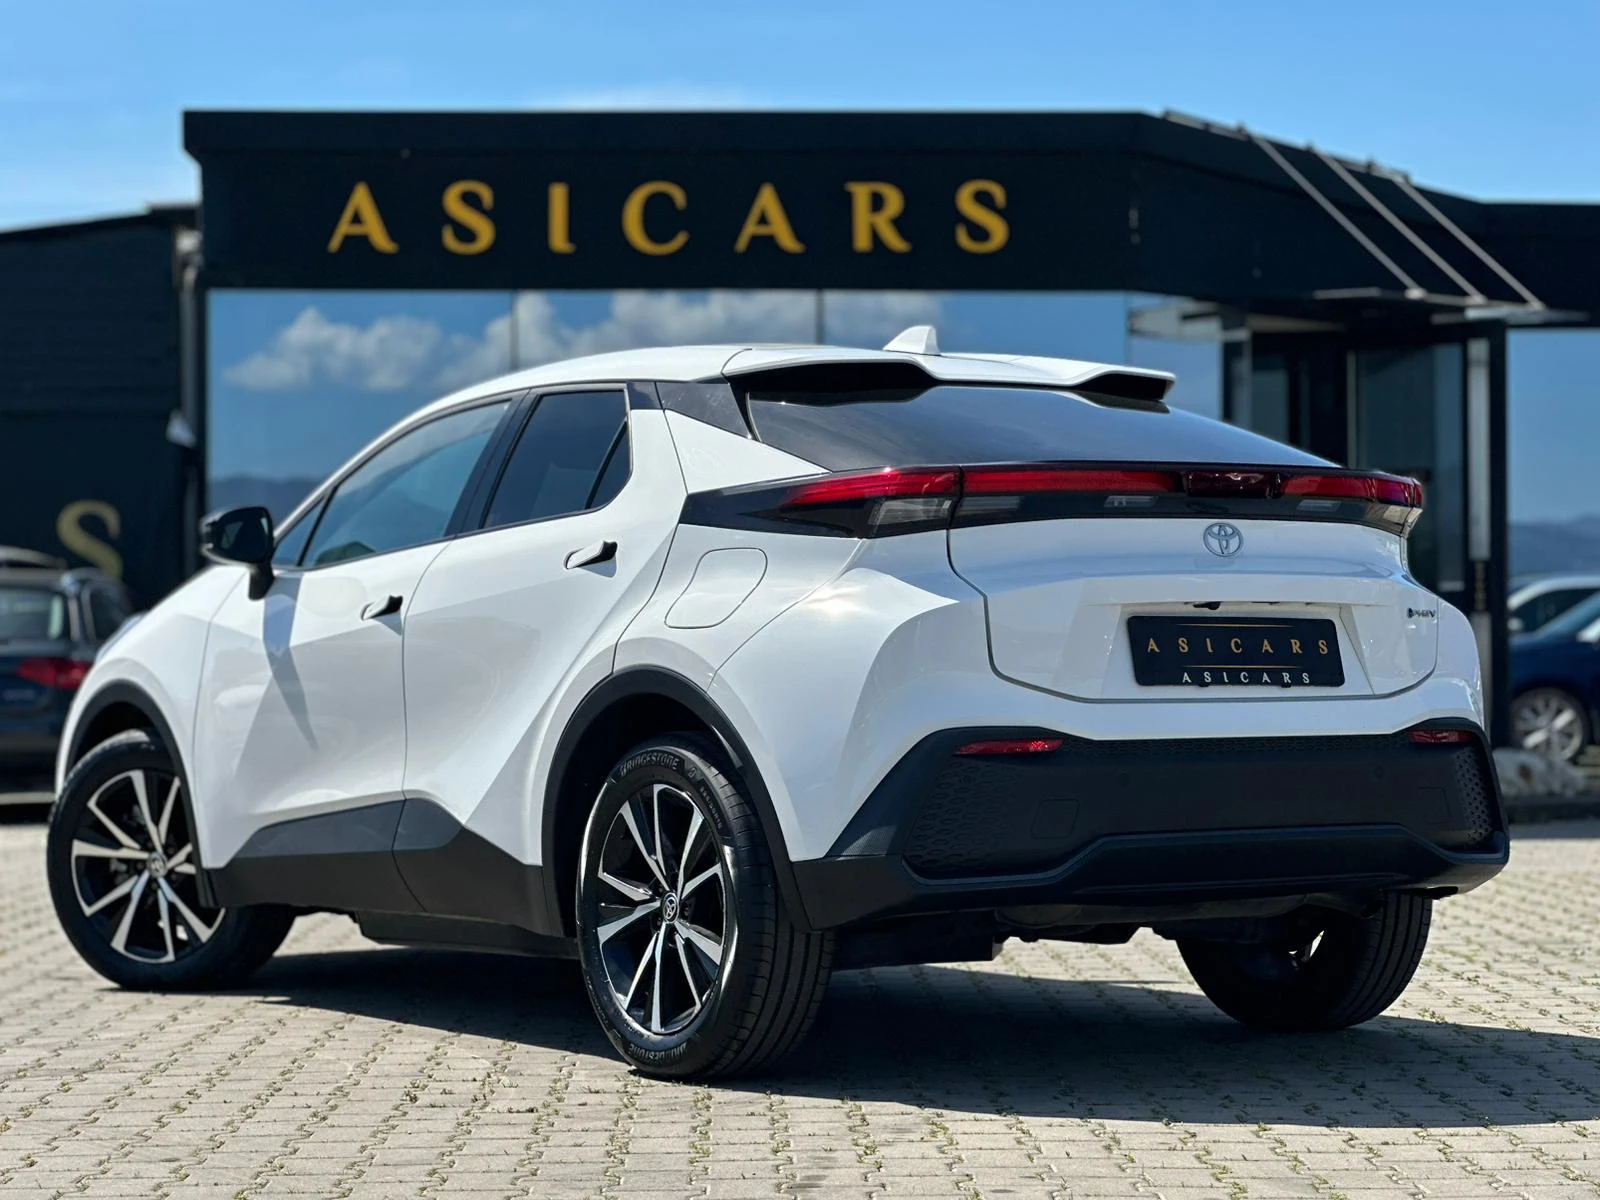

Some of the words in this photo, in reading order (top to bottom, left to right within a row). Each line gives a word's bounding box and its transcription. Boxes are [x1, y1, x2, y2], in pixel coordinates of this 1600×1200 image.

[327, 179, 1011, 256] ASICARS
[1147, 637, 1329, 655] ASICARS
[1181, 670, 1311, 685] ASICARS
[619, 752, 681, 777] BRIDGESTONE
